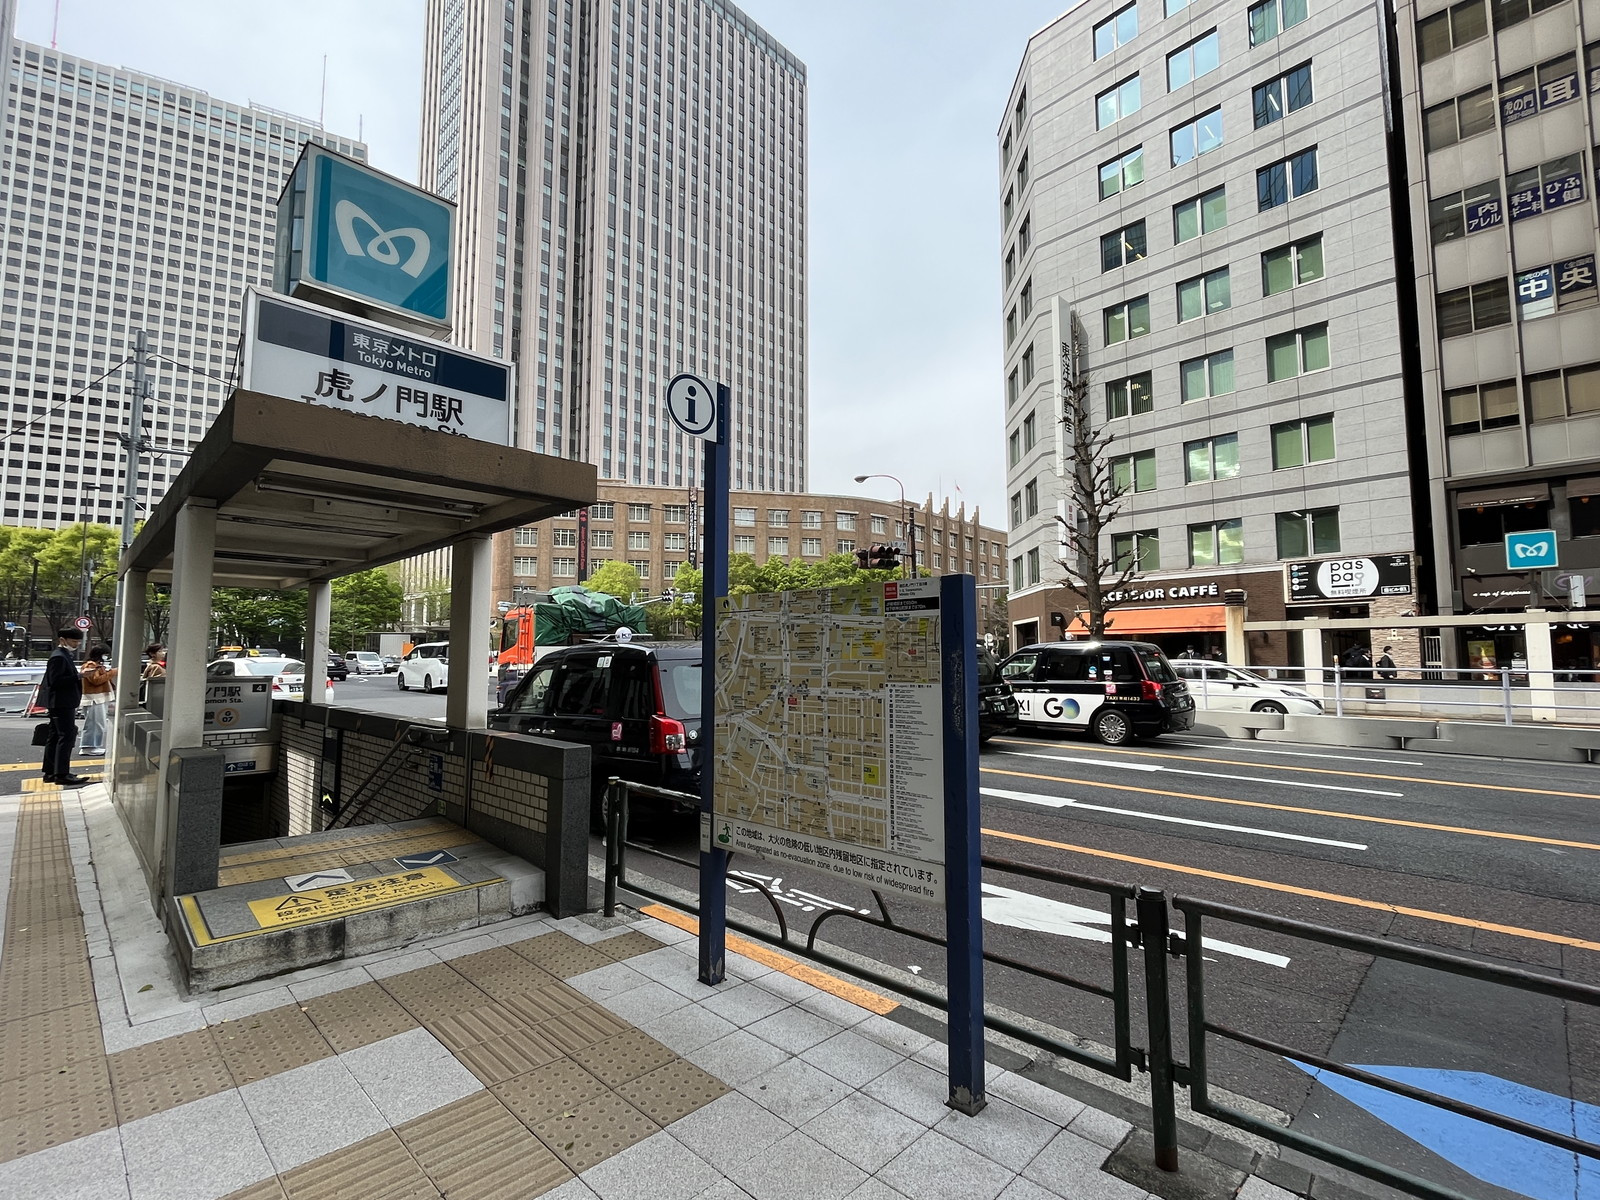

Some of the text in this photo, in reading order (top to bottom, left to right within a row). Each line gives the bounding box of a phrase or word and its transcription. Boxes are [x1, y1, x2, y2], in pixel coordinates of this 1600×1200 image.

[352, 332, 437, 367] 東京メトロ
[357, 350, 431, 378] Tokyo Metro
[314, 367, 465, 427] 虎ノ門駅
[1168, 582, 1218, 598] CAFFÉ
[1018, 699, 1030, 712] XI
[735, 838, 935, 898] Area designated as no-evacuation zone, due to low risk of widespread fire
[324, 872, 427, 898] 足元注意
